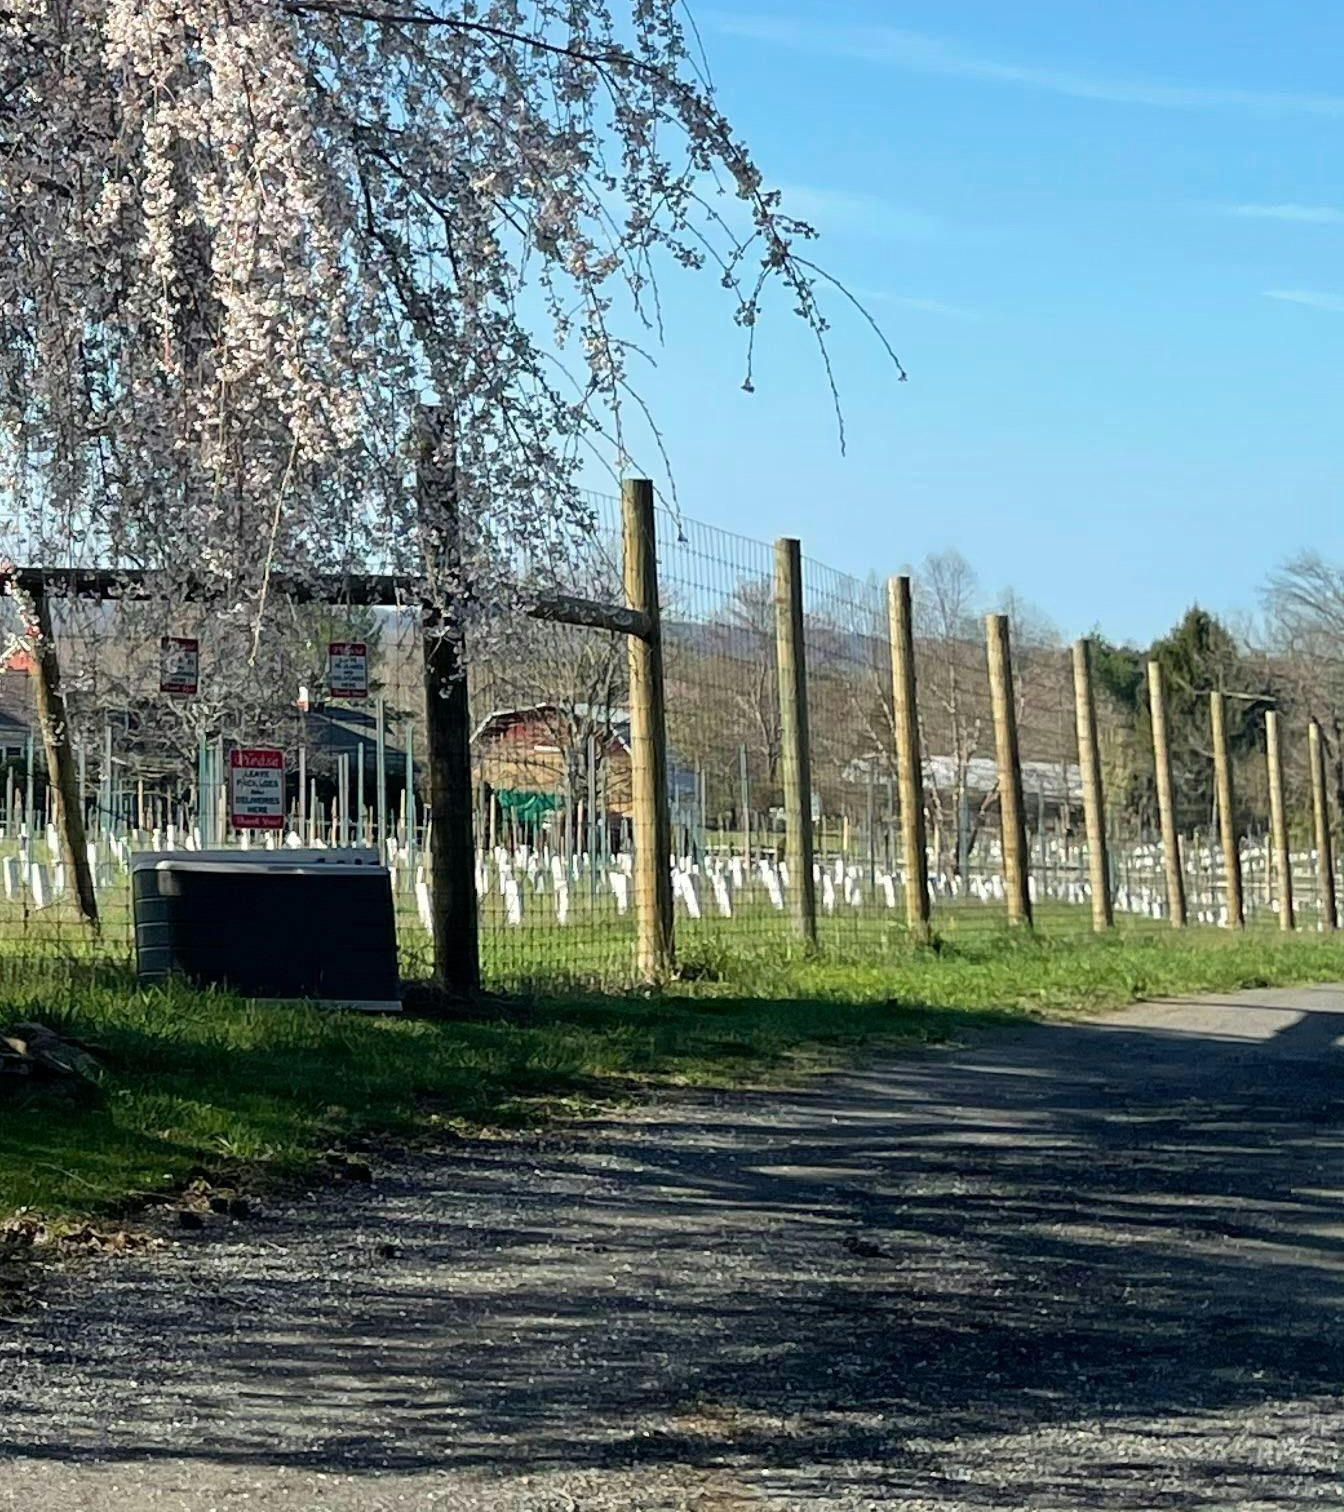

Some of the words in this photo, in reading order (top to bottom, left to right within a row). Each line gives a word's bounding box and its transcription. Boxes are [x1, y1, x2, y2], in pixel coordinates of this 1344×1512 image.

[234, 752, 279, 767] Please
[244, 770, 269, 778] LEAVE
[235, 796, 280, 805] DELIVERIES
[247, 806, 267, 814] HERE
